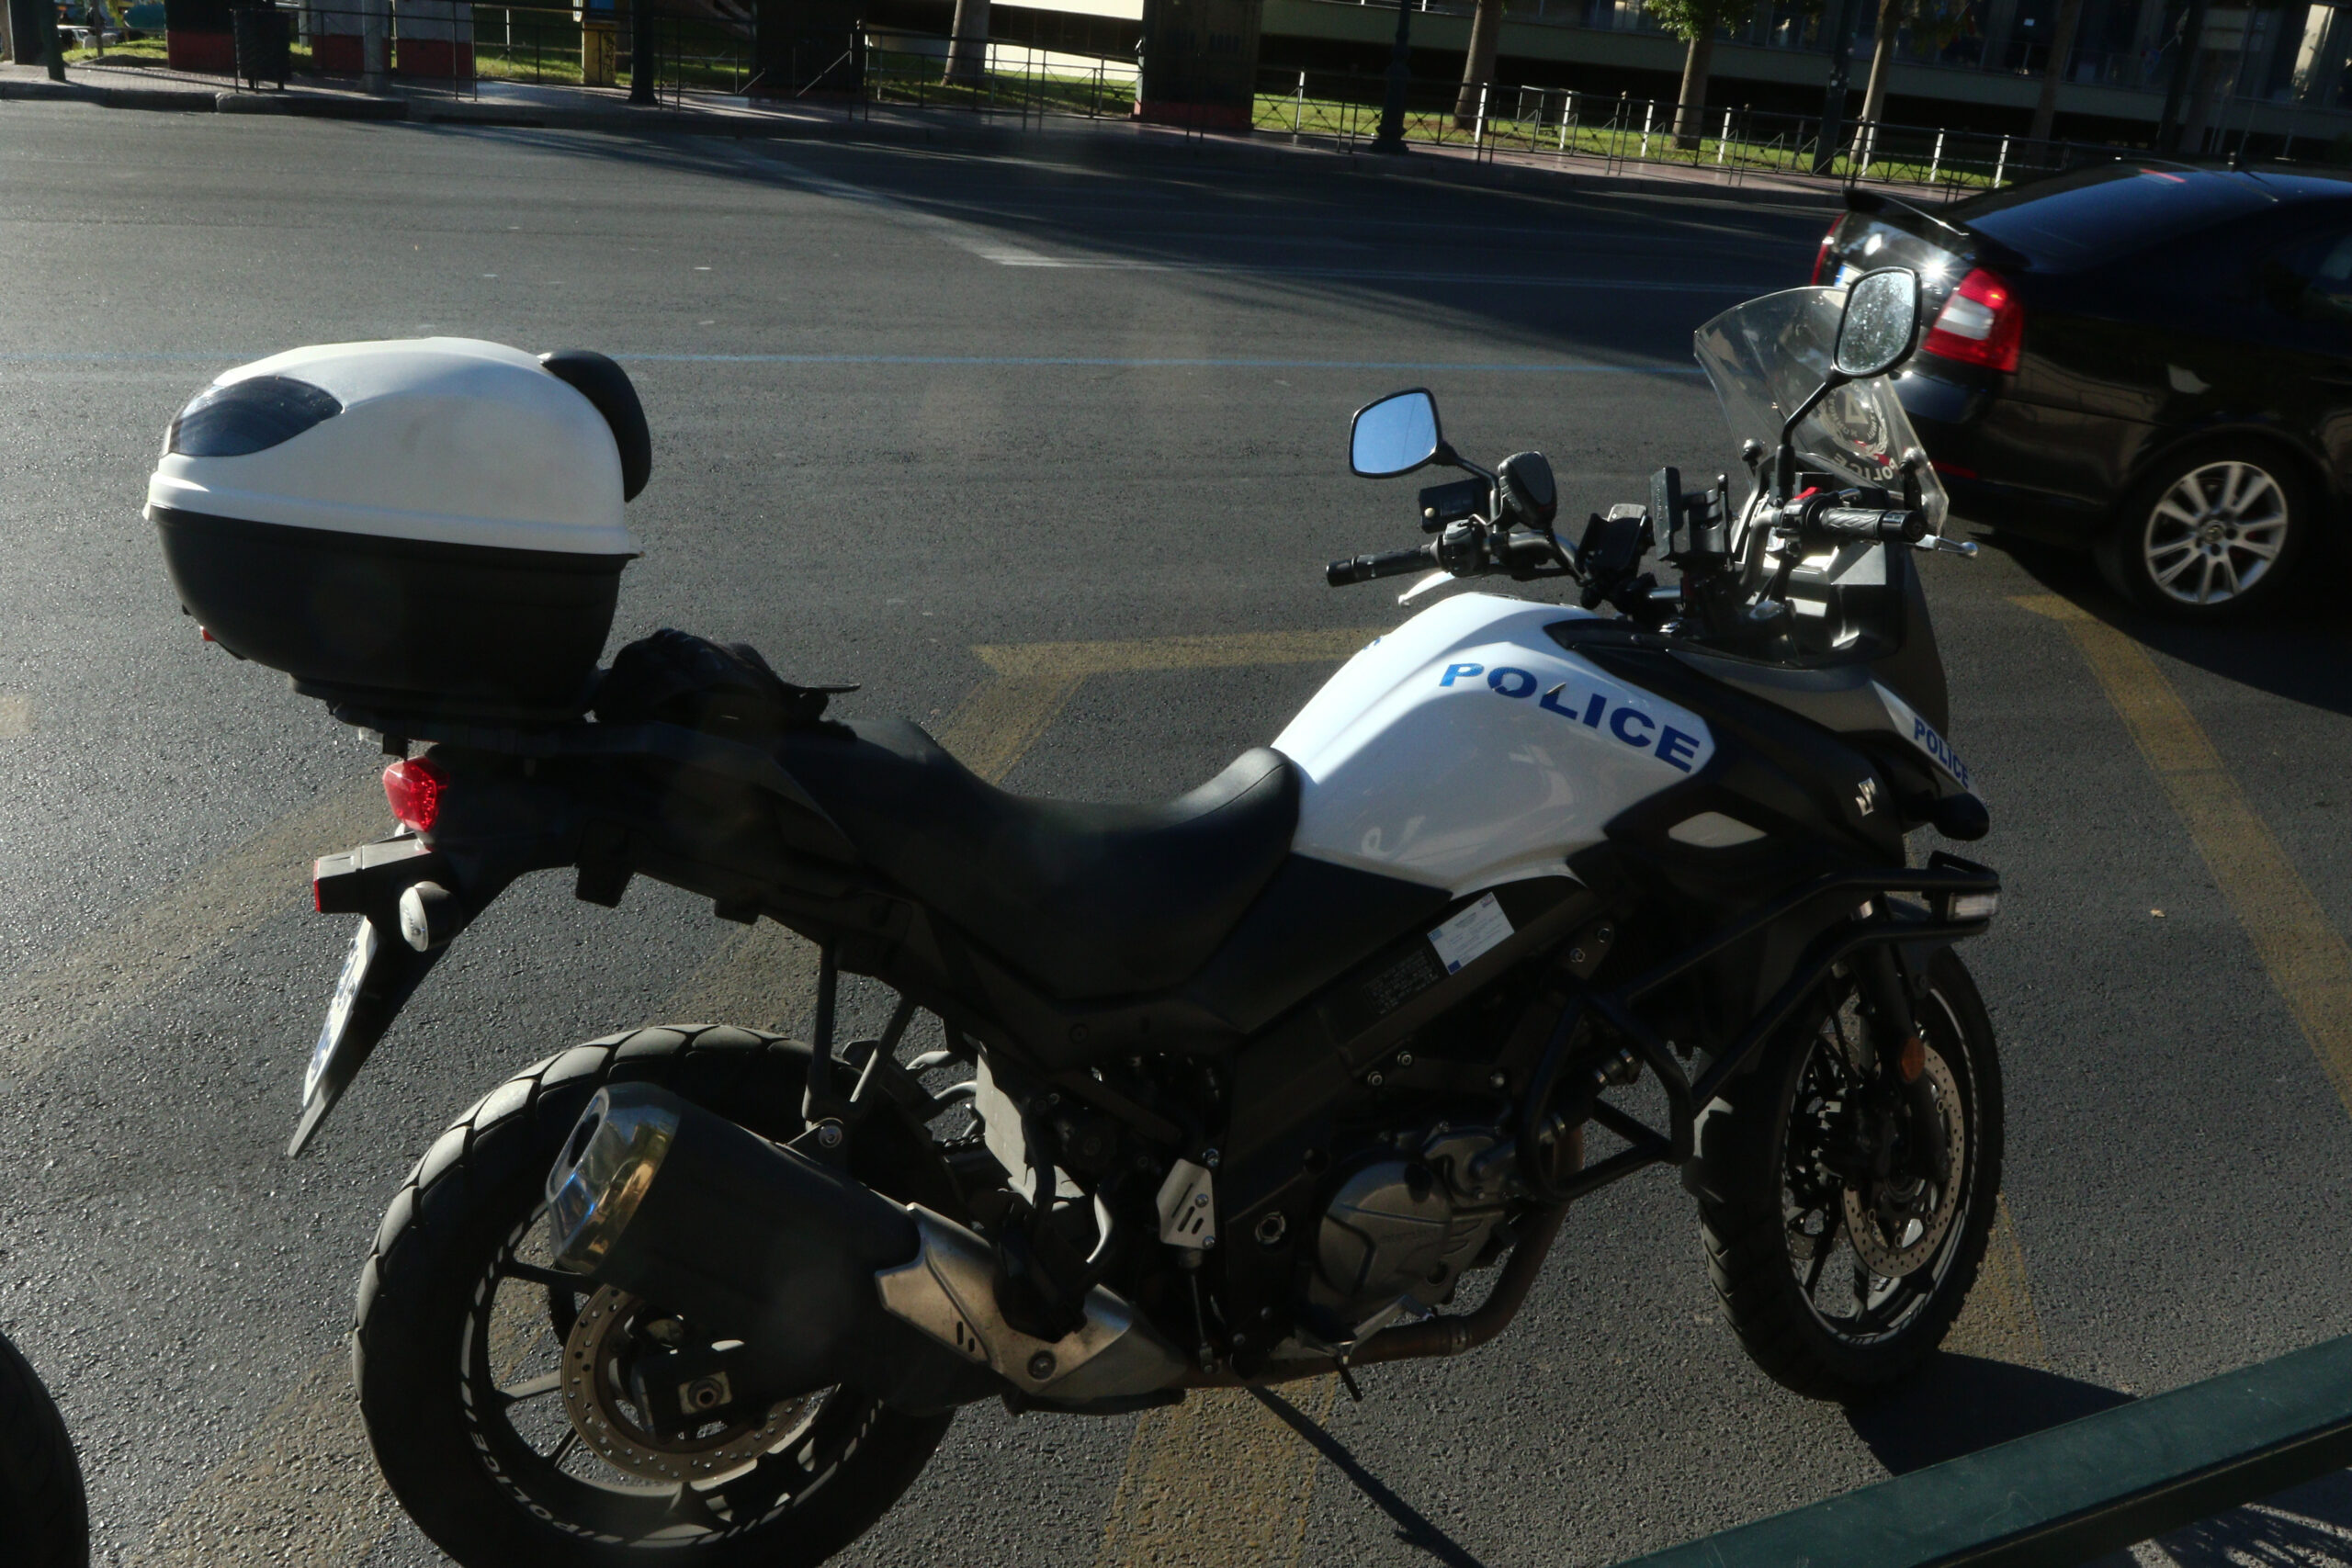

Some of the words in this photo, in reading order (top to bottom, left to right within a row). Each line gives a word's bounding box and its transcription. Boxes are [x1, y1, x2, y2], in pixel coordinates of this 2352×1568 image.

[1439, 662, 1701, 773] POLICE
[1914, 716, 1969, 790] POLICE
[469, 1431, 581, 1534] POLICE
